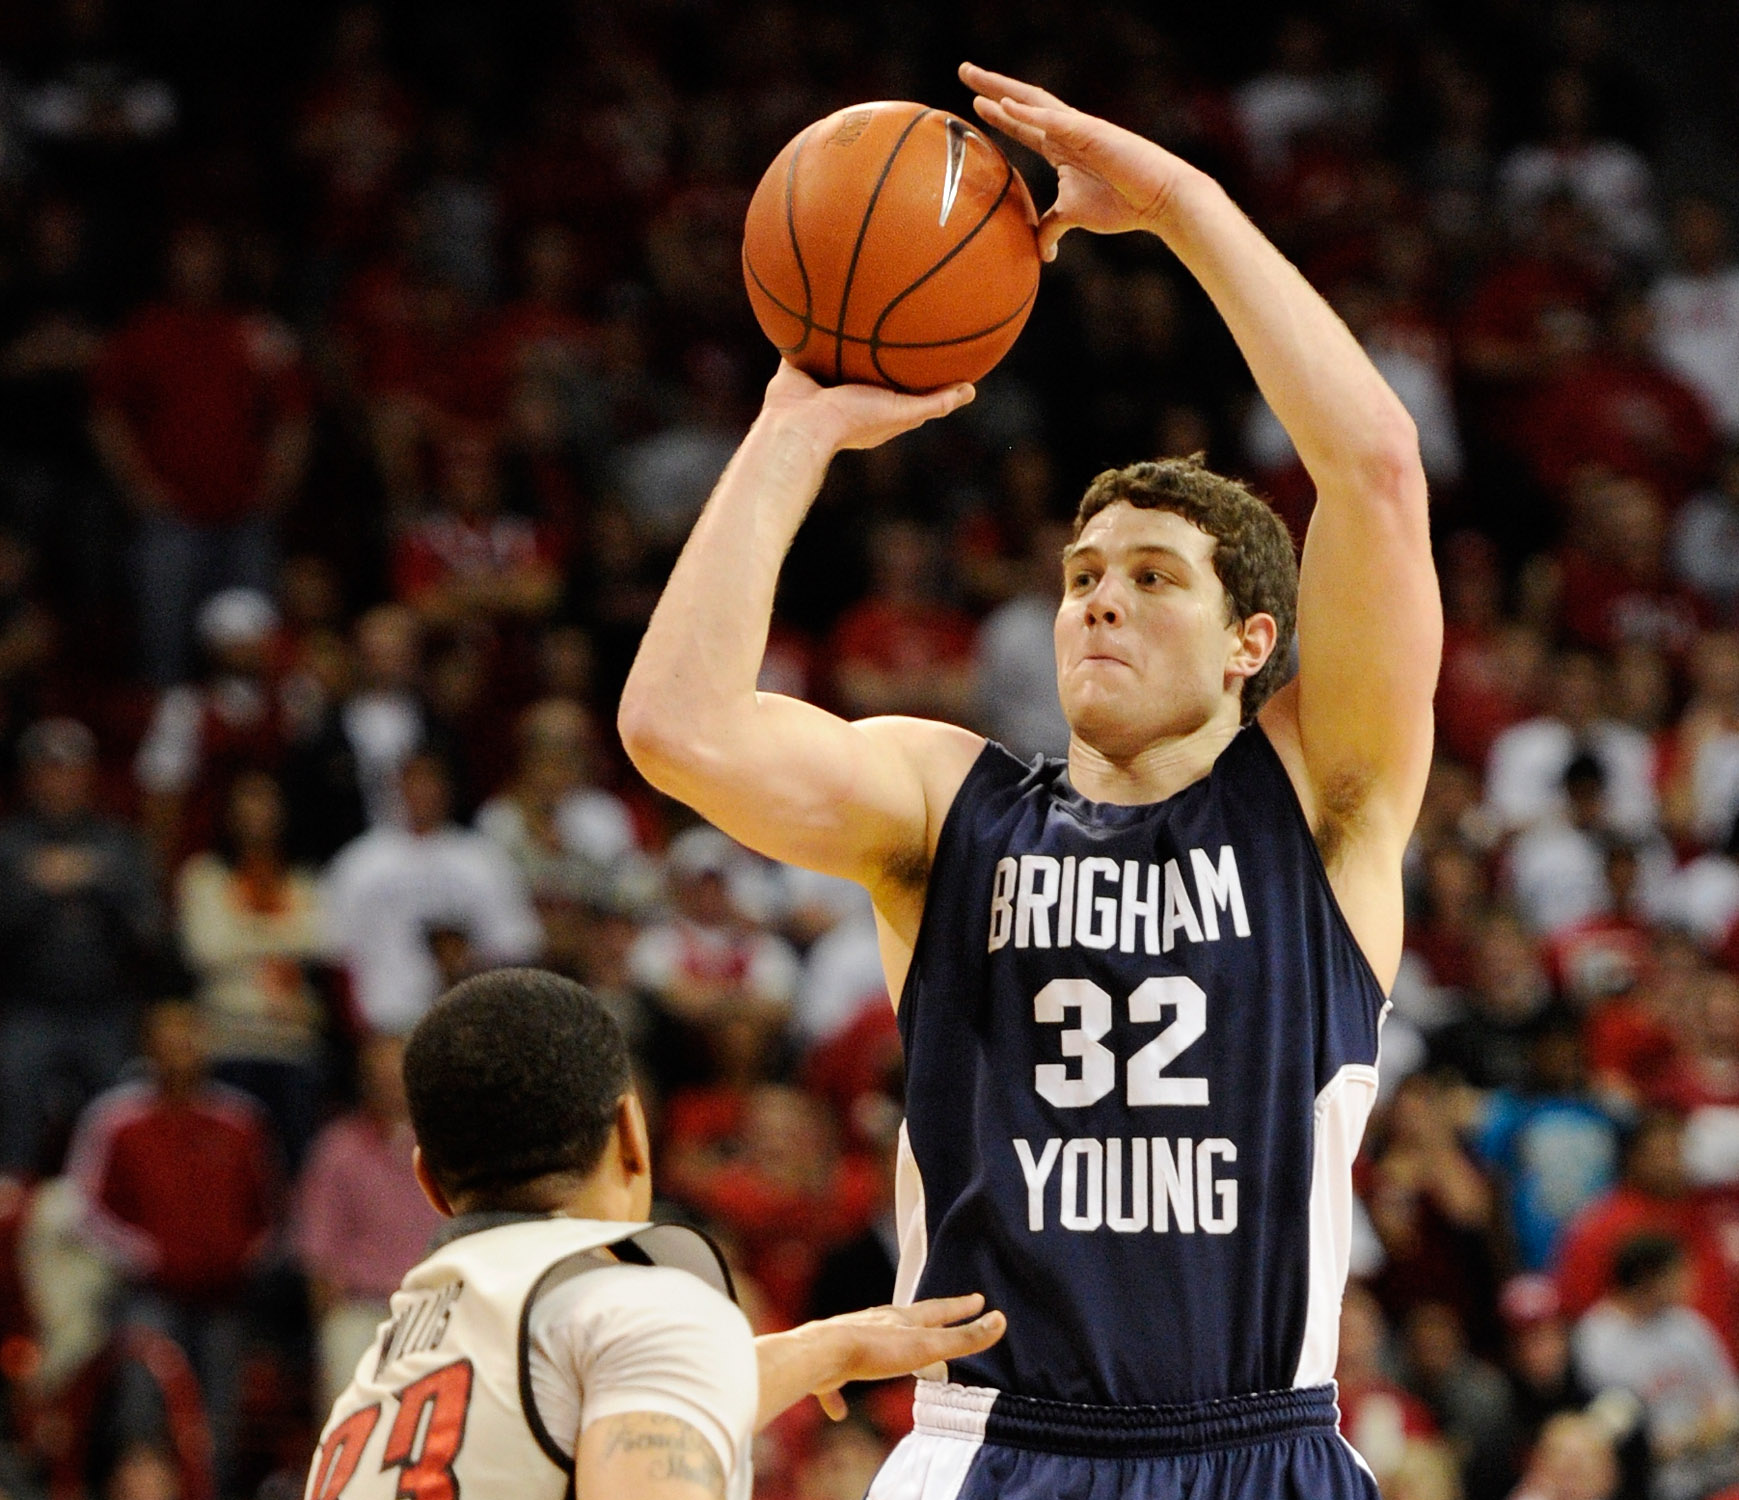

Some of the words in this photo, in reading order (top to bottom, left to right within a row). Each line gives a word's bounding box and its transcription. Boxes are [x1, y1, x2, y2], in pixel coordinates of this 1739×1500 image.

[988, 845, 1251, 955] BRIGHAM
[1034, 976, 1209, 1108] 32
[1012, 1137, 1238, 1235] YOUNG
